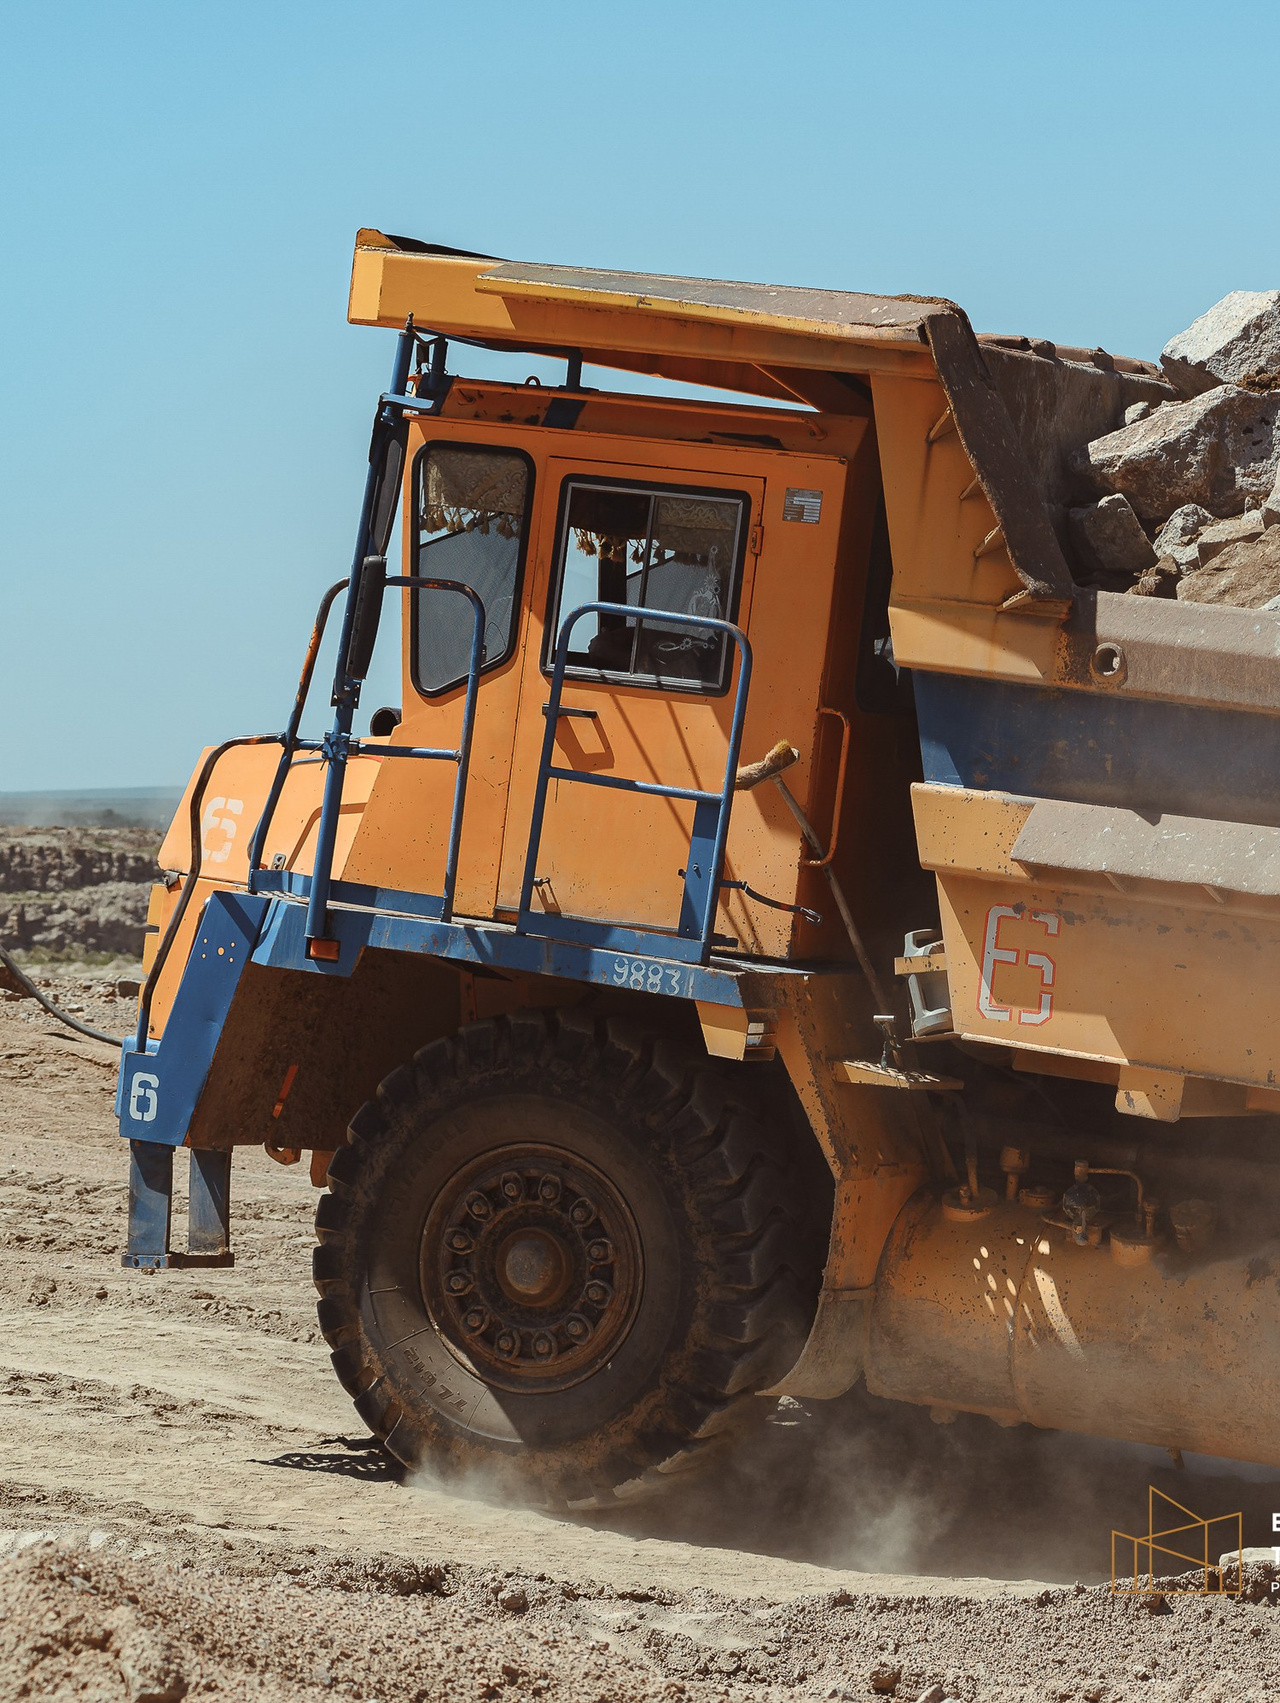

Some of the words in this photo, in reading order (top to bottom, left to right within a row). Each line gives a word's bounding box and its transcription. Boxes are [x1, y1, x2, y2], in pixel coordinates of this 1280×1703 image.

[202, 796, 244, 863] 6
[976, 903, 1061, 1027] 6
[129, 1071, 160, 1122] 6
